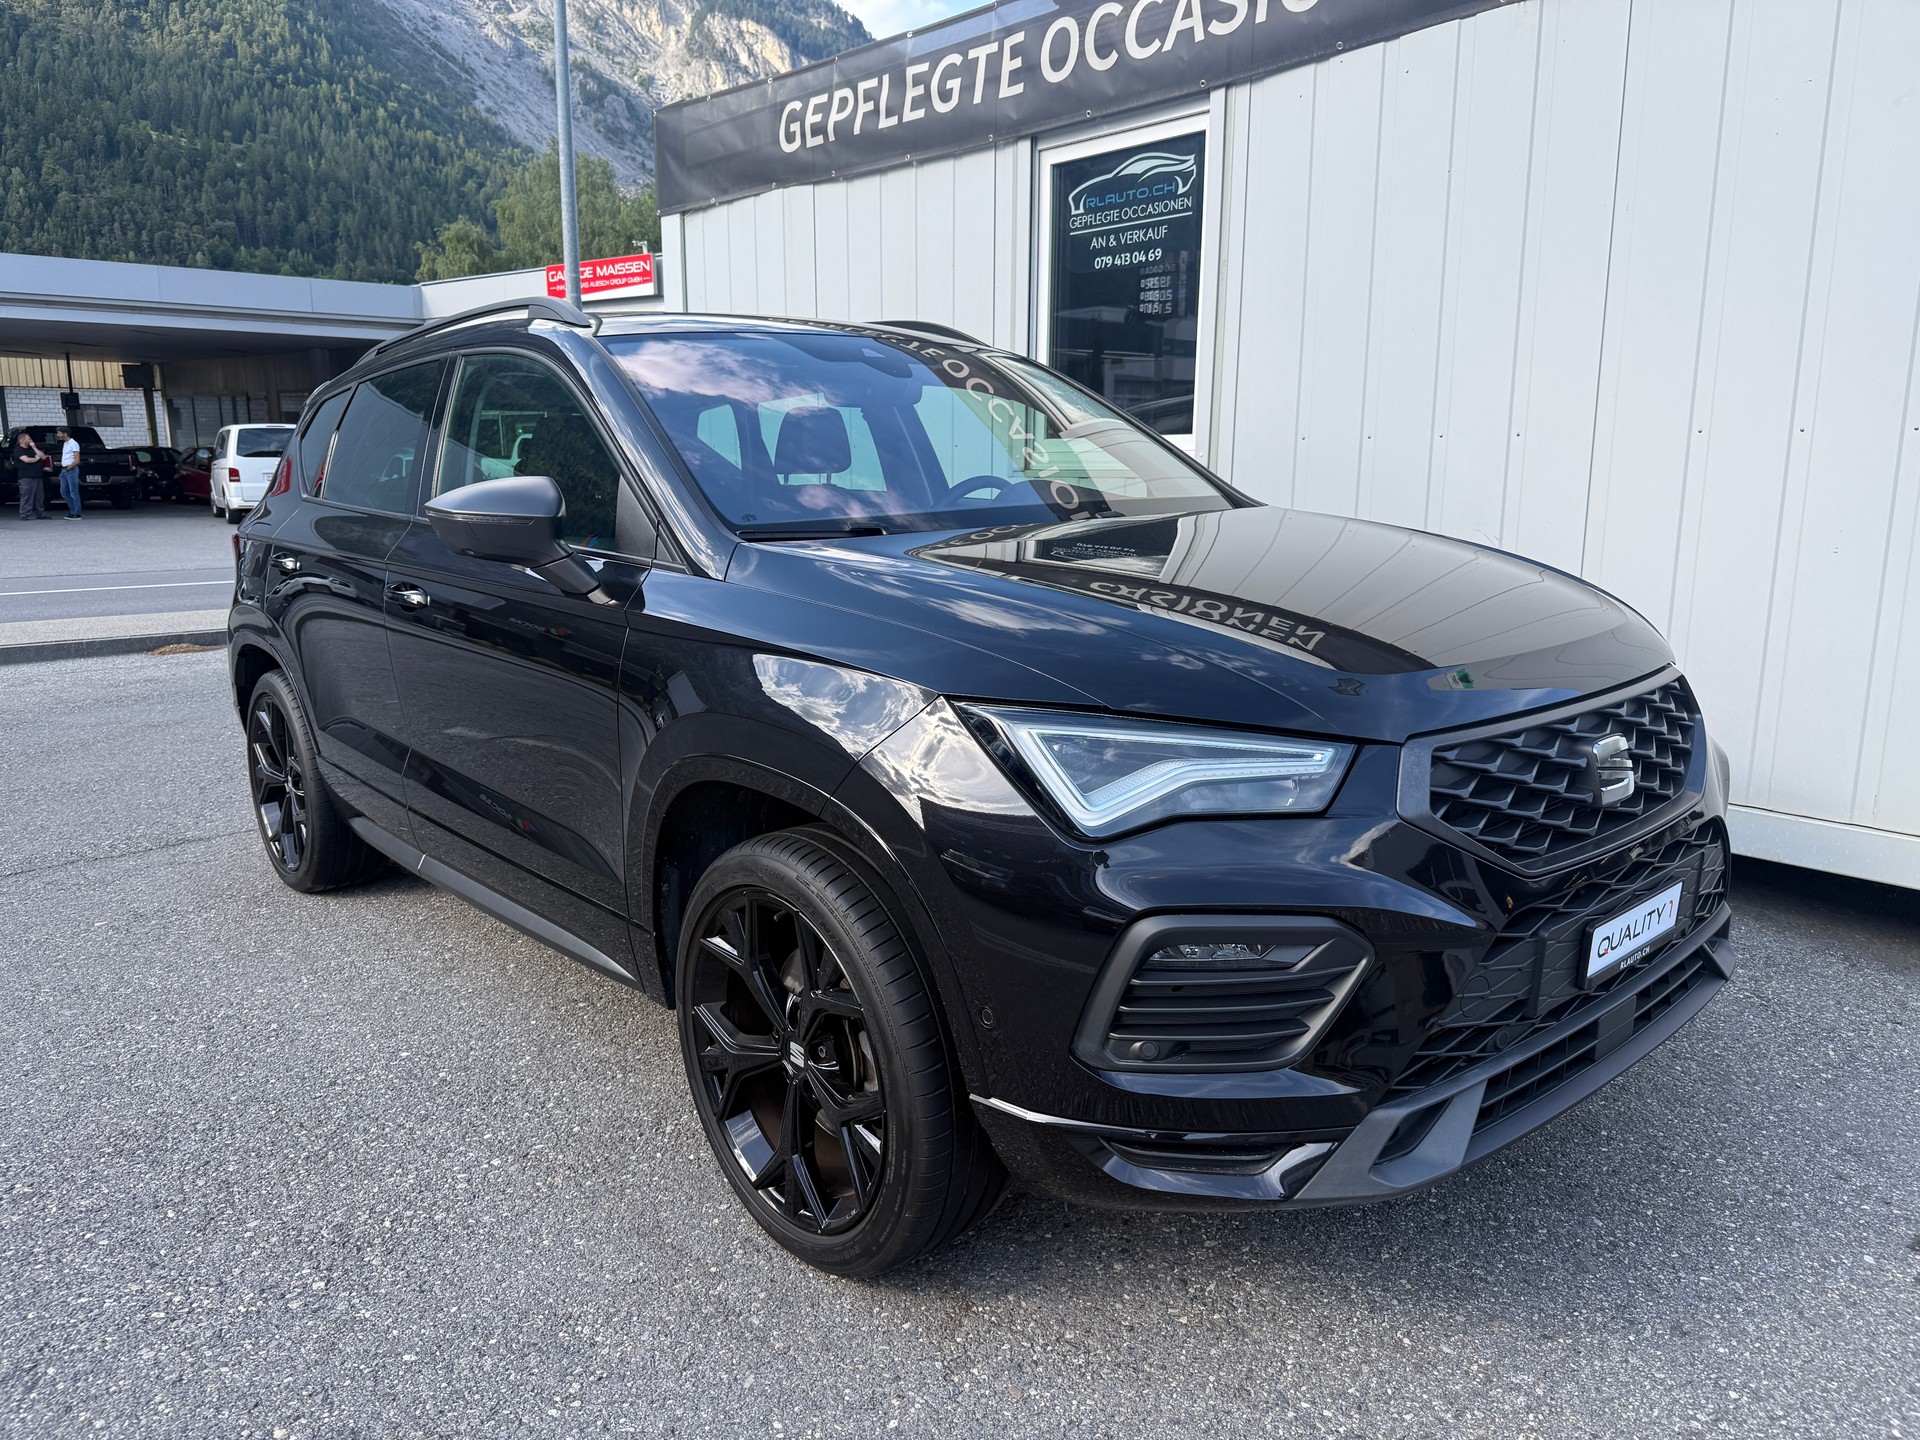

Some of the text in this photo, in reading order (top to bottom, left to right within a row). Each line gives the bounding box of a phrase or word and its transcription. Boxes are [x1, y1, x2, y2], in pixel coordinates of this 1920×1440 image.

[778, 0, 1319, 153] GEPFLEGTE OCCAS
[1086, 182, 1176, 209] RLAUTO.CH
[1069, 196, 1193, 229] GEPFLEGTE OCCASIONEN
[1089, 225, 1168, 250] AN & VERKAUF
[548, 260, 651, 282] GAGE MAISSEN
[1094, 248, 1162, 269] 079 413 04 69
[1597, 903, 1667, 958] QUALITY
[1619, 946, 1651, 970] RLAUTO.CH
